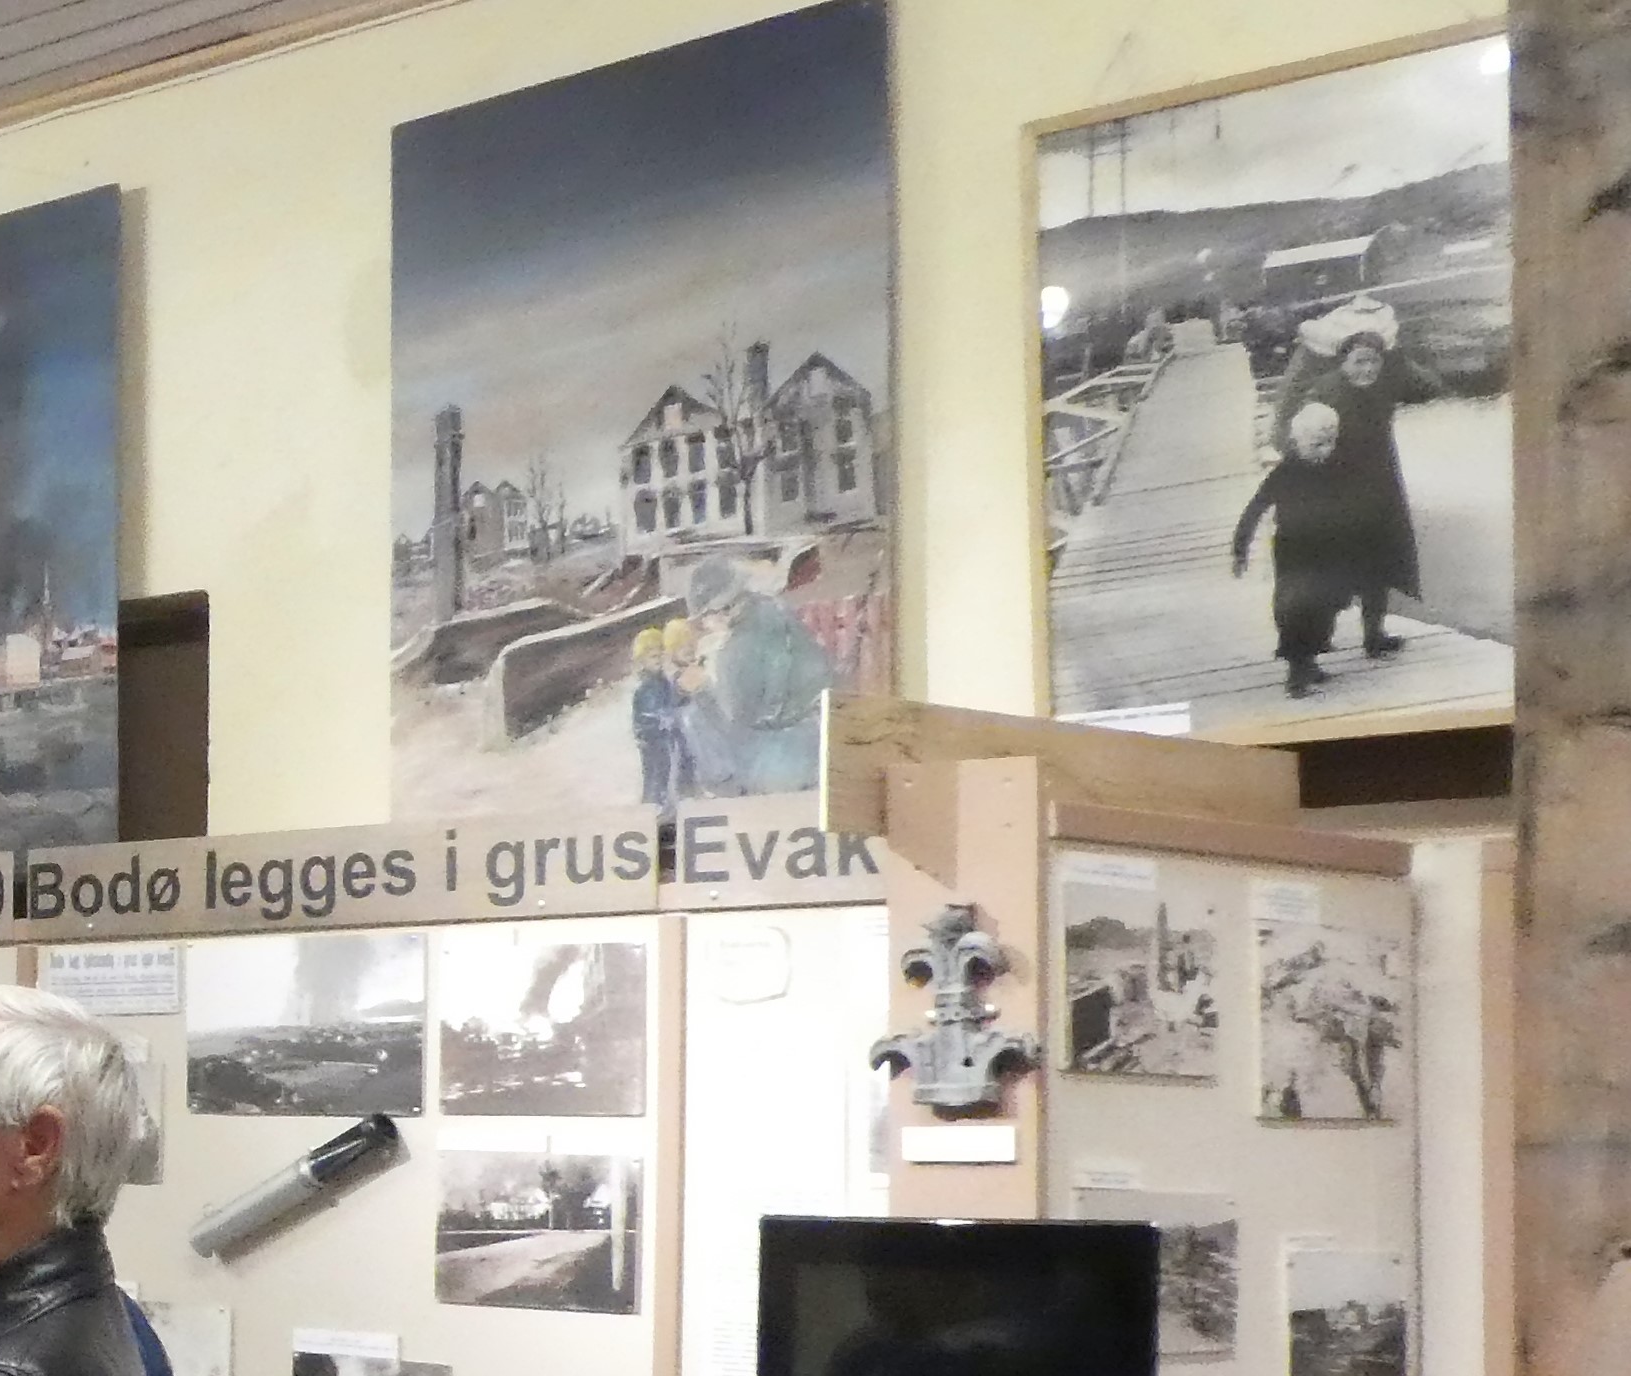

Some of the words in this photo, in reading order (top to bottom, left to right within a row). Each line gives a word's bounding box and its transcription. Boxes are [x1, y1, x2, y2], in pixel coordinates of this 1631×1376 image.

[29, 851, 181, 919] Bodø
[204, 849, 418, 921] legges
[444, 828, 458, 892] i
[485, 830, 653, 907] grus
